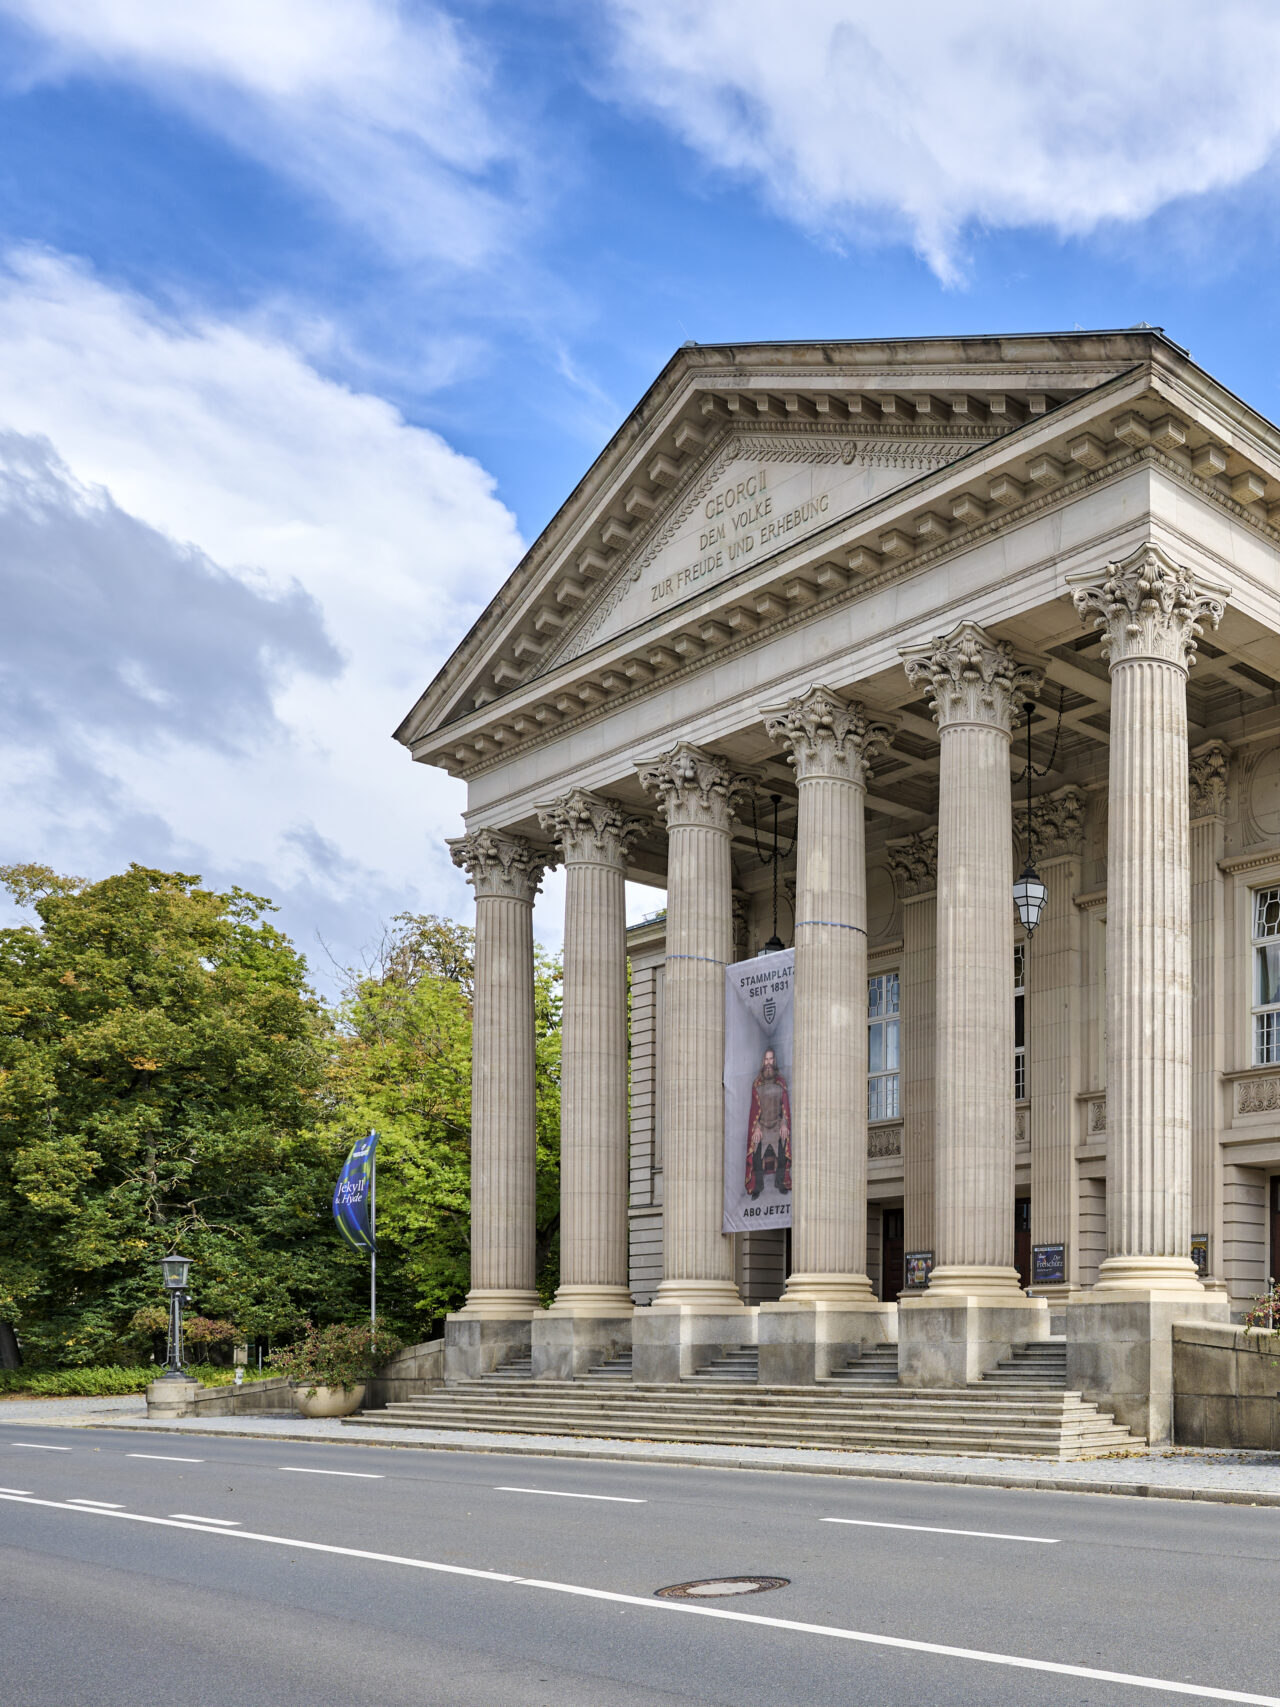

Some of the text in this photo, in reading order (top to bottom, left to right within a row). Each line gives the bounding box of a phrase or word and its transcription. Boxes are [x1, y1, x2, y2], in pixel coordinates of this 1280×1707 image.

[705, 469, 767, 519] GEORG II
[700, 497, 772, 551] DEM VOLKE
[651, 494, 829, 602] ZUR FREUDE UND ERHEBUNG
[749, 980, 789, 997] SEIT 1831
[337, 1179, 364, 1196] Jekyll
[341, 1193, 363, 1205] Hyde
[743, 1204, 791, 1218] ABO JETZT
